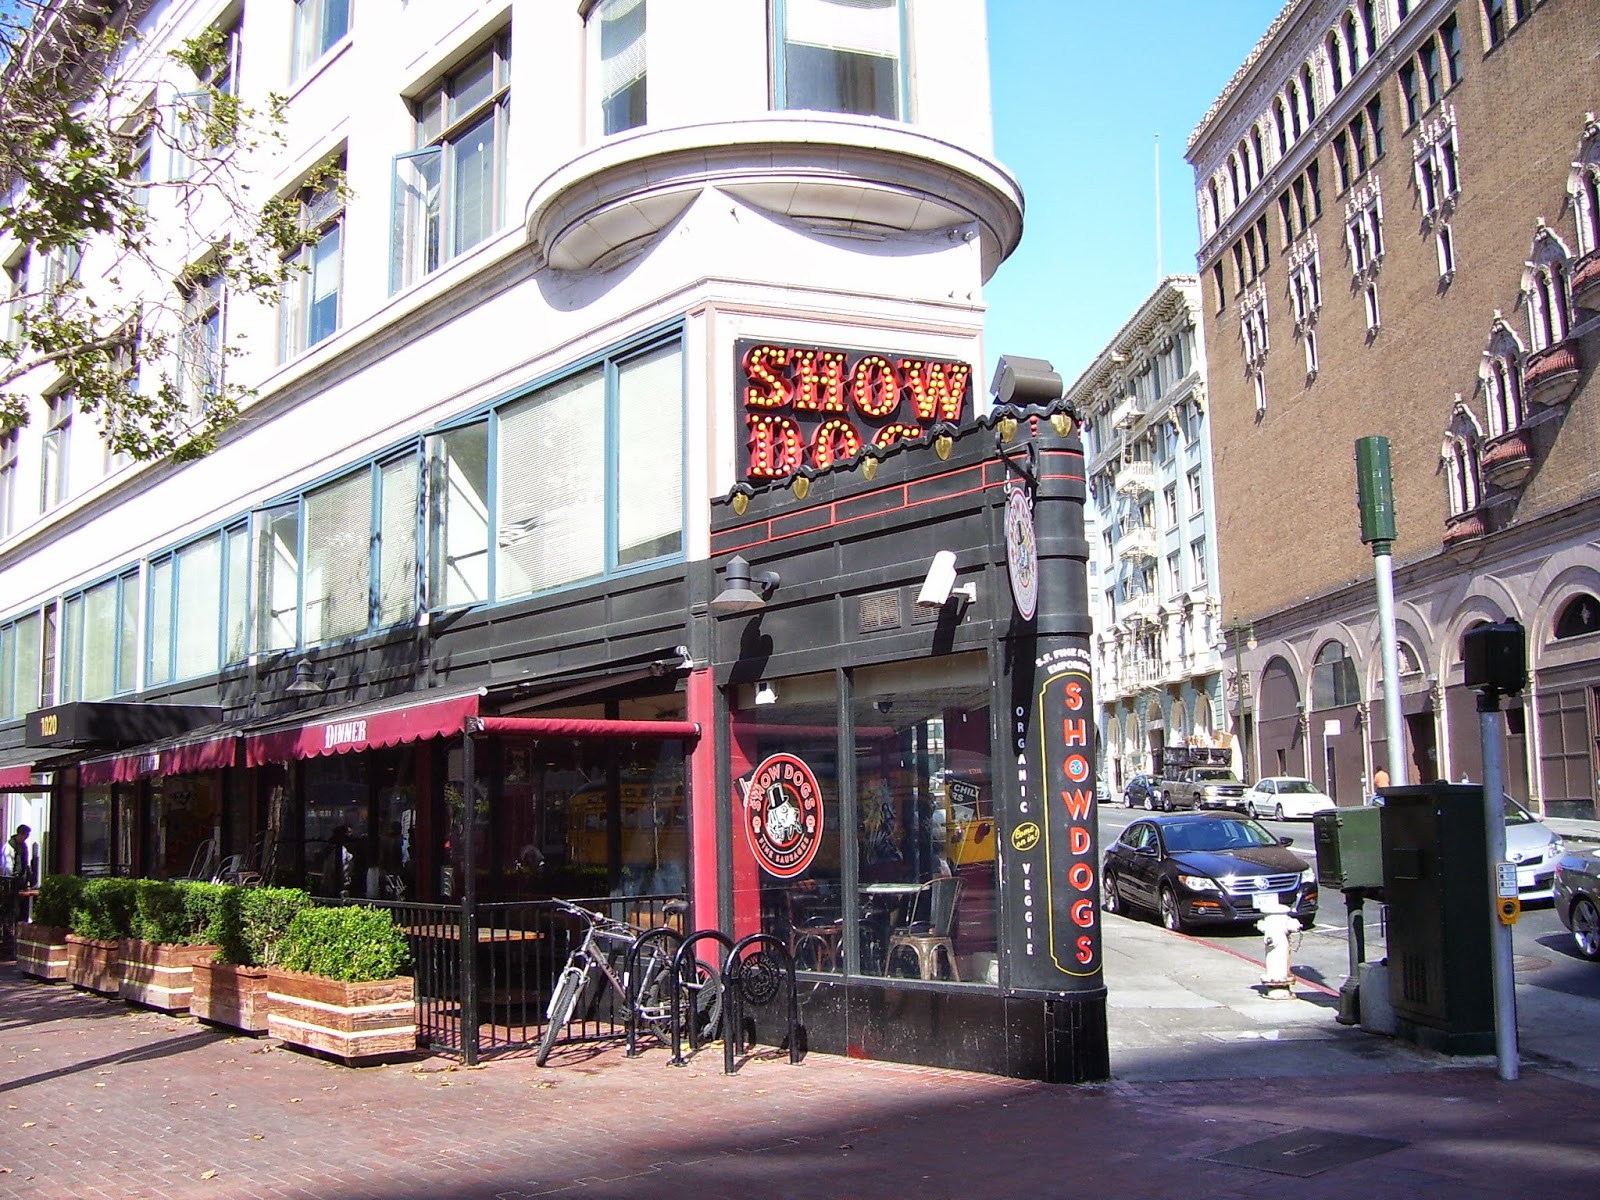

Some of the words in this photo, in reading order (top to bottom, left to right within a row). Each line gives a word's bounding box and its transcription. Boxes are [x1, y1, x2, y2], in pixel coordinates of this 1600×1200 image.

[743, 344, 972, 421] SHOW
[40, 714, 58, 737] 1020
[325, 720, 367, 748] DINNER
[751, 763, 781, 812] SHOW
[784, 763, 816, 811] DOGS
[1015, 706, 1029, 813] ORGANIC
[1022, 863, 1033, 955] VEGGIE
